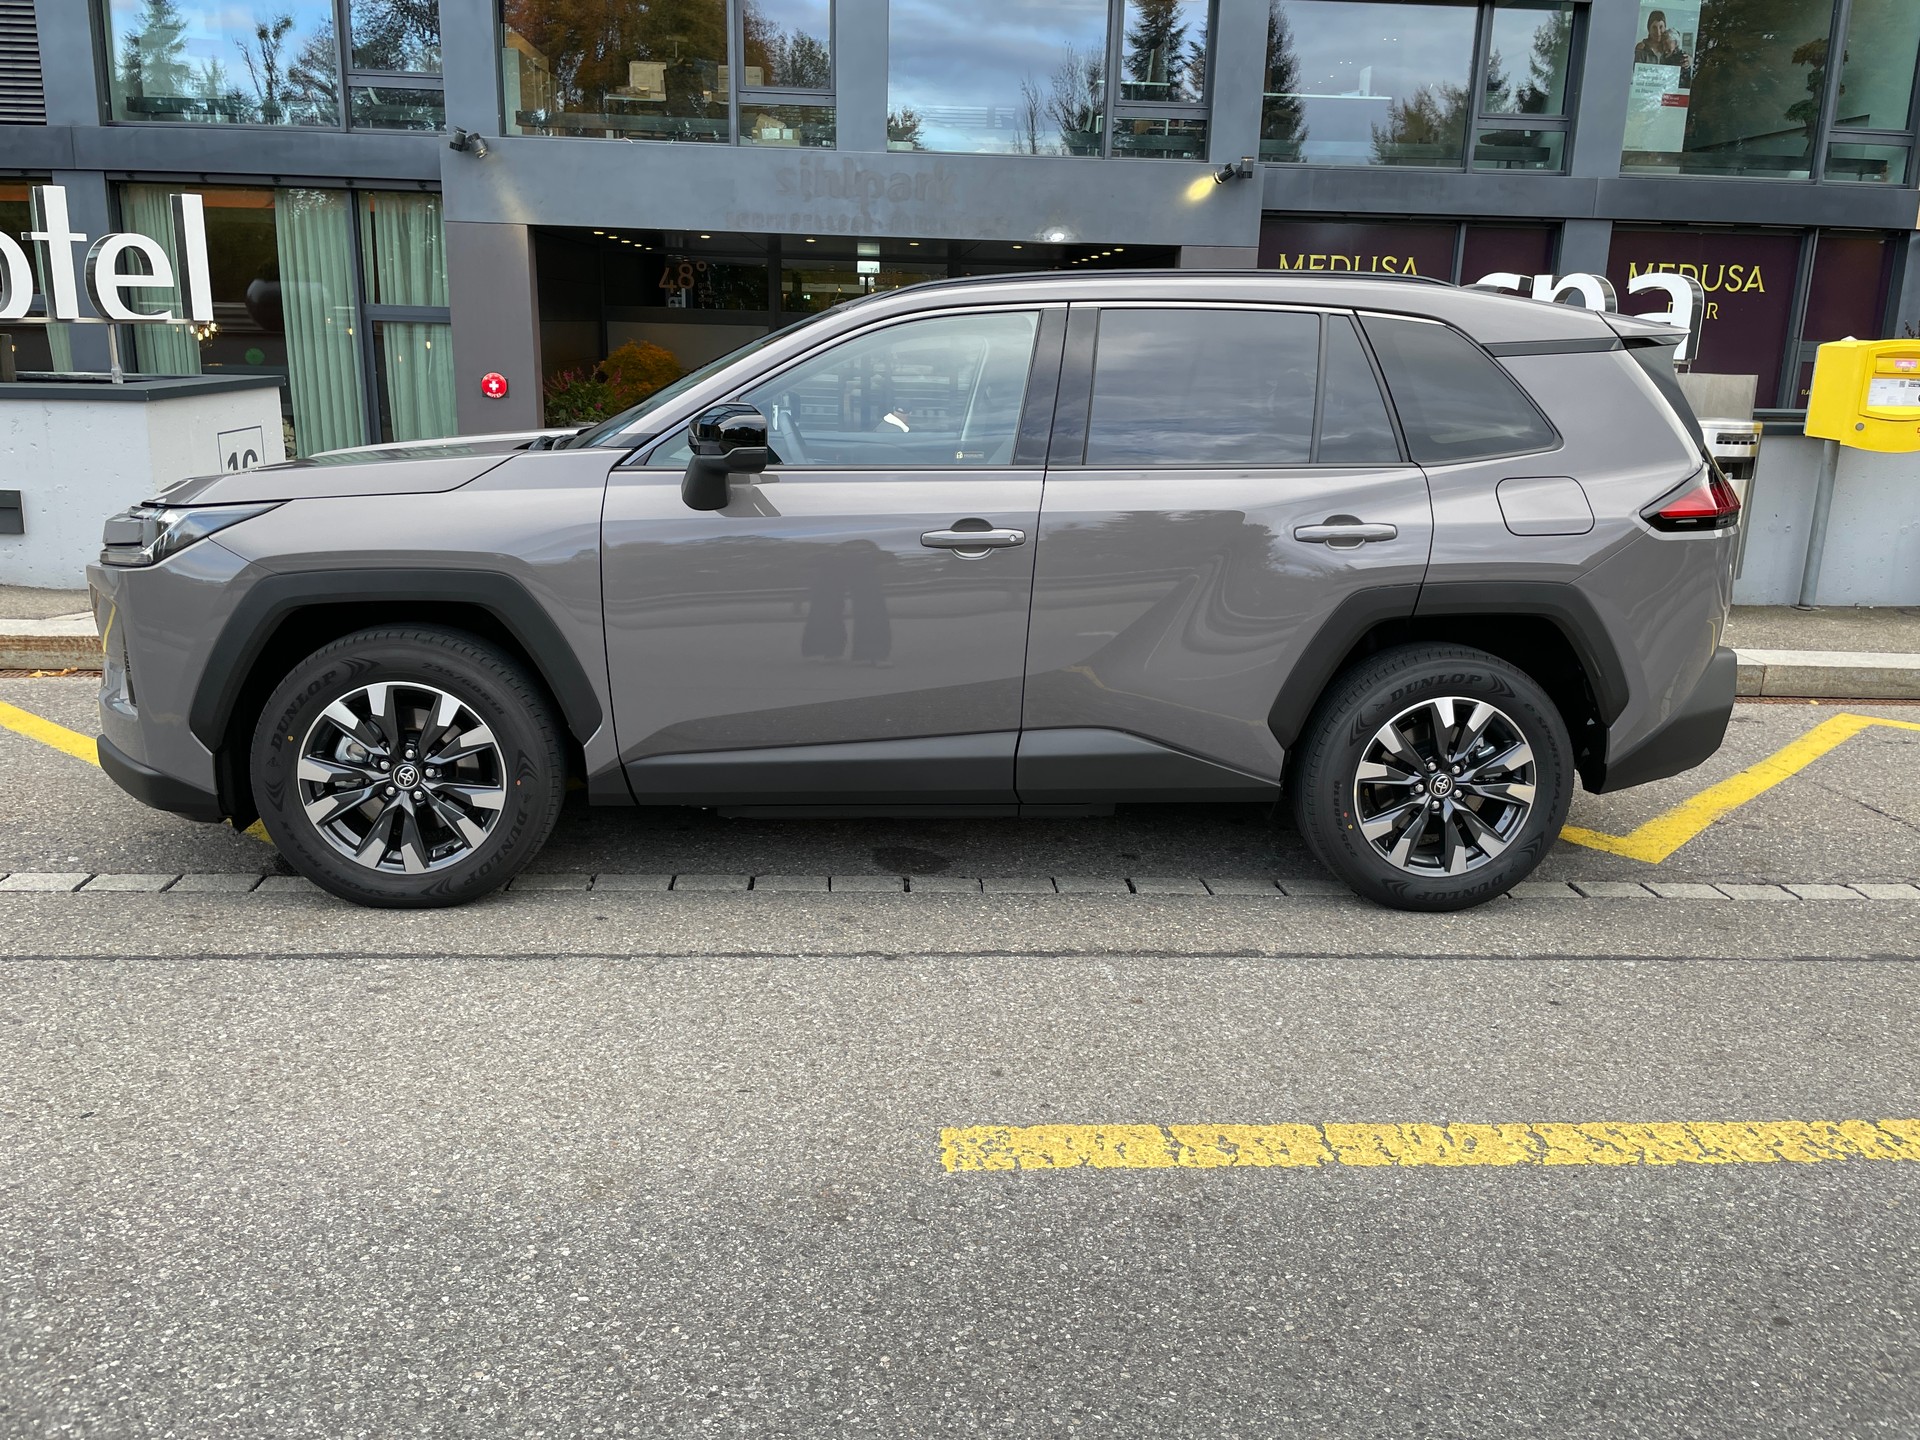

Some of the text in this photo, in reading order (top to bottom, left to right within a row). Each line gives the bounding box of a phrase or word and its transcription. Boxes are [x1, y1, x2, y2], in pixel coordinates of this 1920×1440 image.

[270, 670, 337, 752] DUNLOP
[1390, 673, 1482, 702] DUNLOP
[464, 809, 528, 887] DUNLOP
[1415, 872, 1504, 902] DUNLOP
